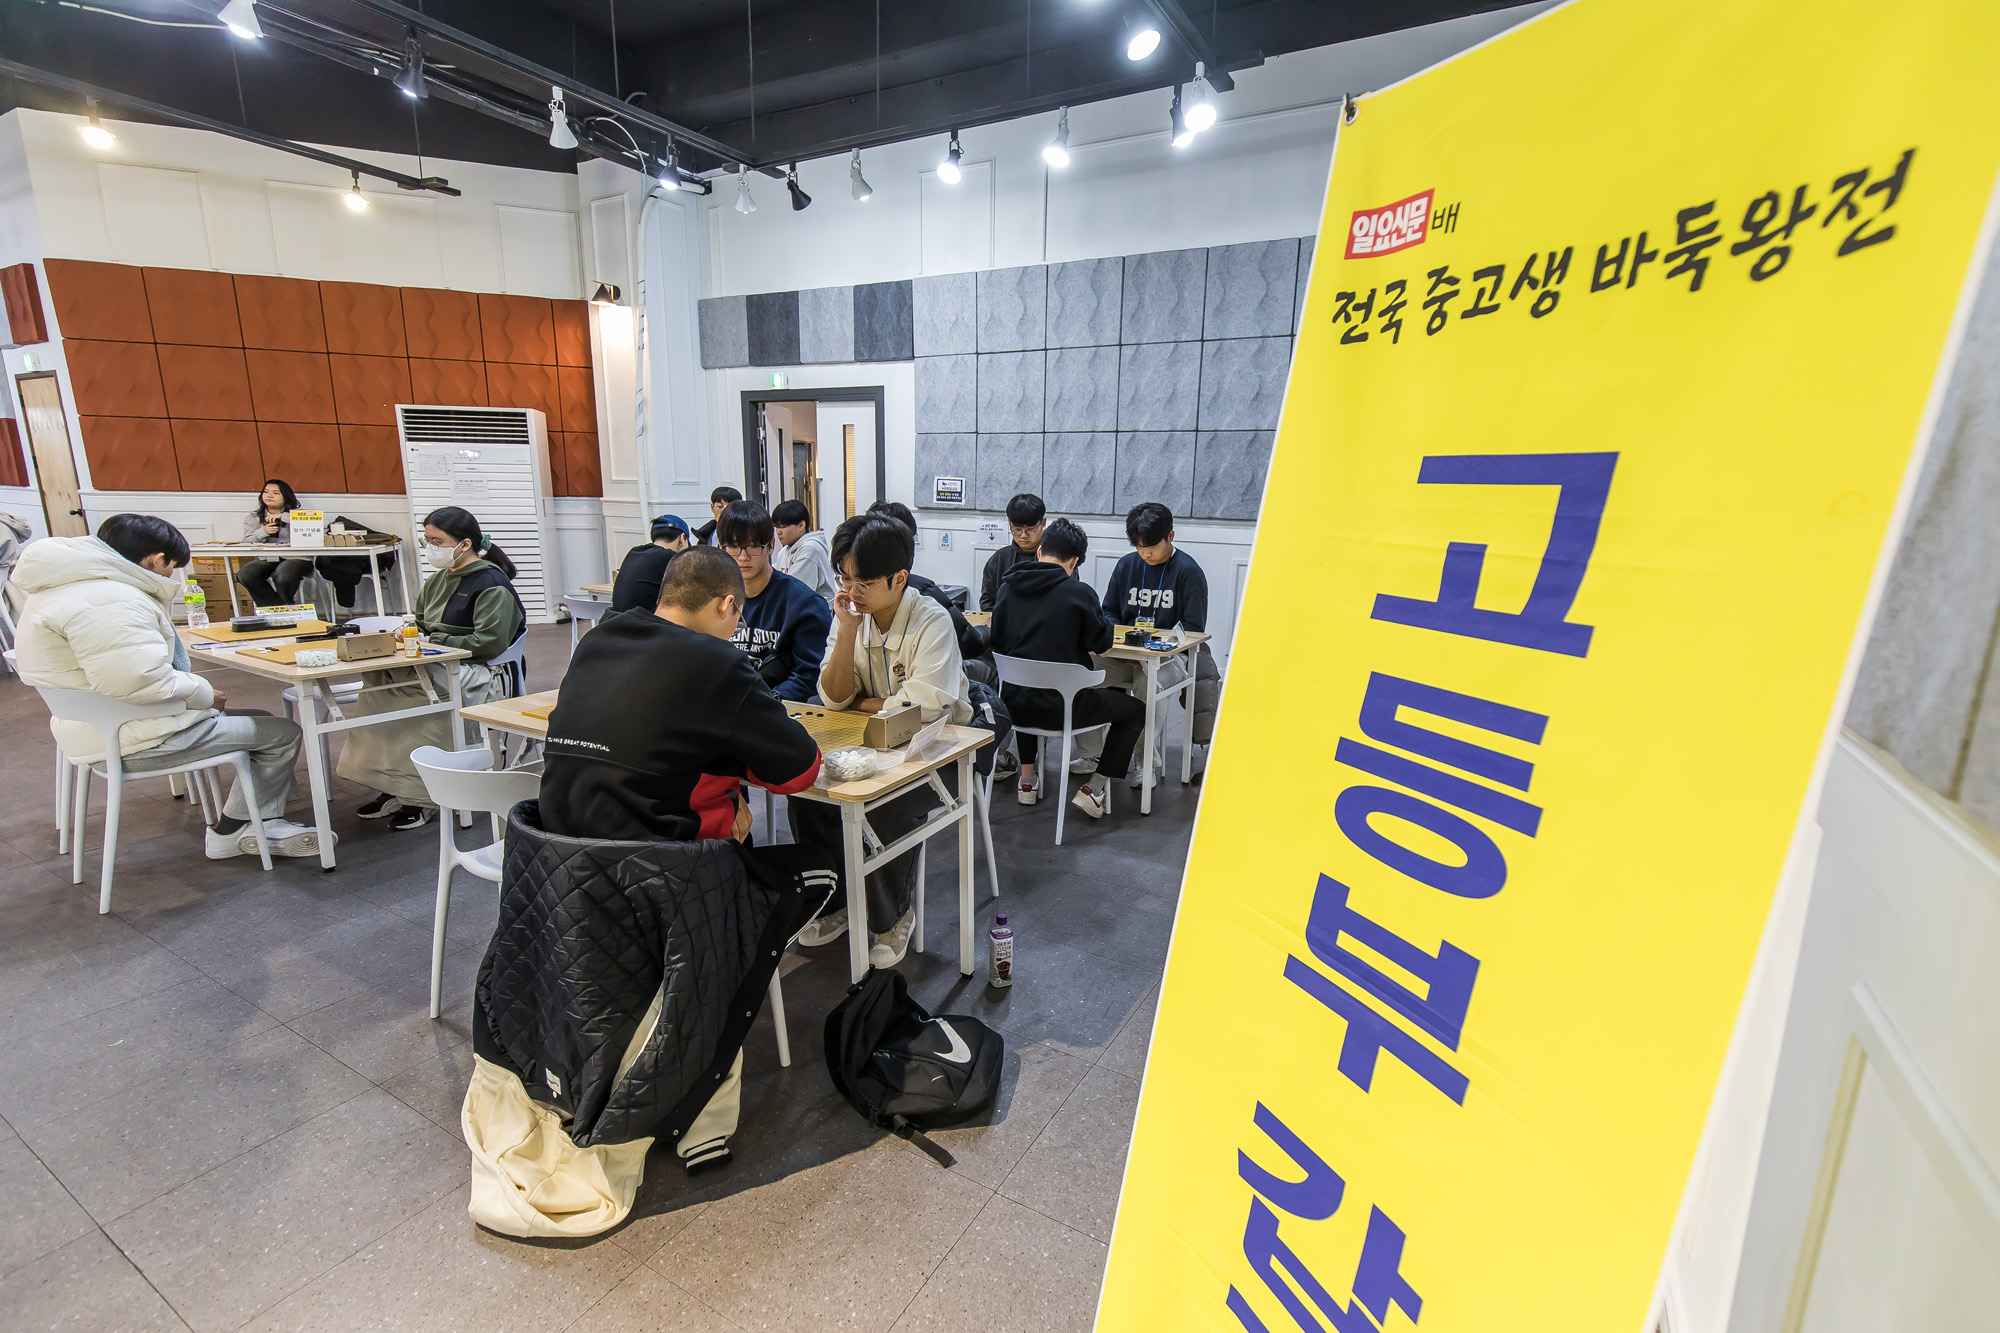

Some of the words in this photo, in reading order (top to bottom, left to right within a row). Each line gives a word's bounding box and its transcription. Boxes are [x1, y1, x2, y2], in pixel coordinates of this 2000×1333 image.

[1332, 279, 1408, 345] 전국
[1423, 246, 1574, 337] 중고생
[1590, 148, 1916, 293] 바둑왕전
[1352, 197, 1428, 254] 일요신문
[1431, 202, 1461, 234] 배
[1128, 587, 1174, 608] 1979
[728, 627, 751, 643] ON
[580, 741, 610, 752] POTENTIAL
[1284, 452, 1619, 1106] 고등부
[1226, 1100, 1423, 1333] 갑
